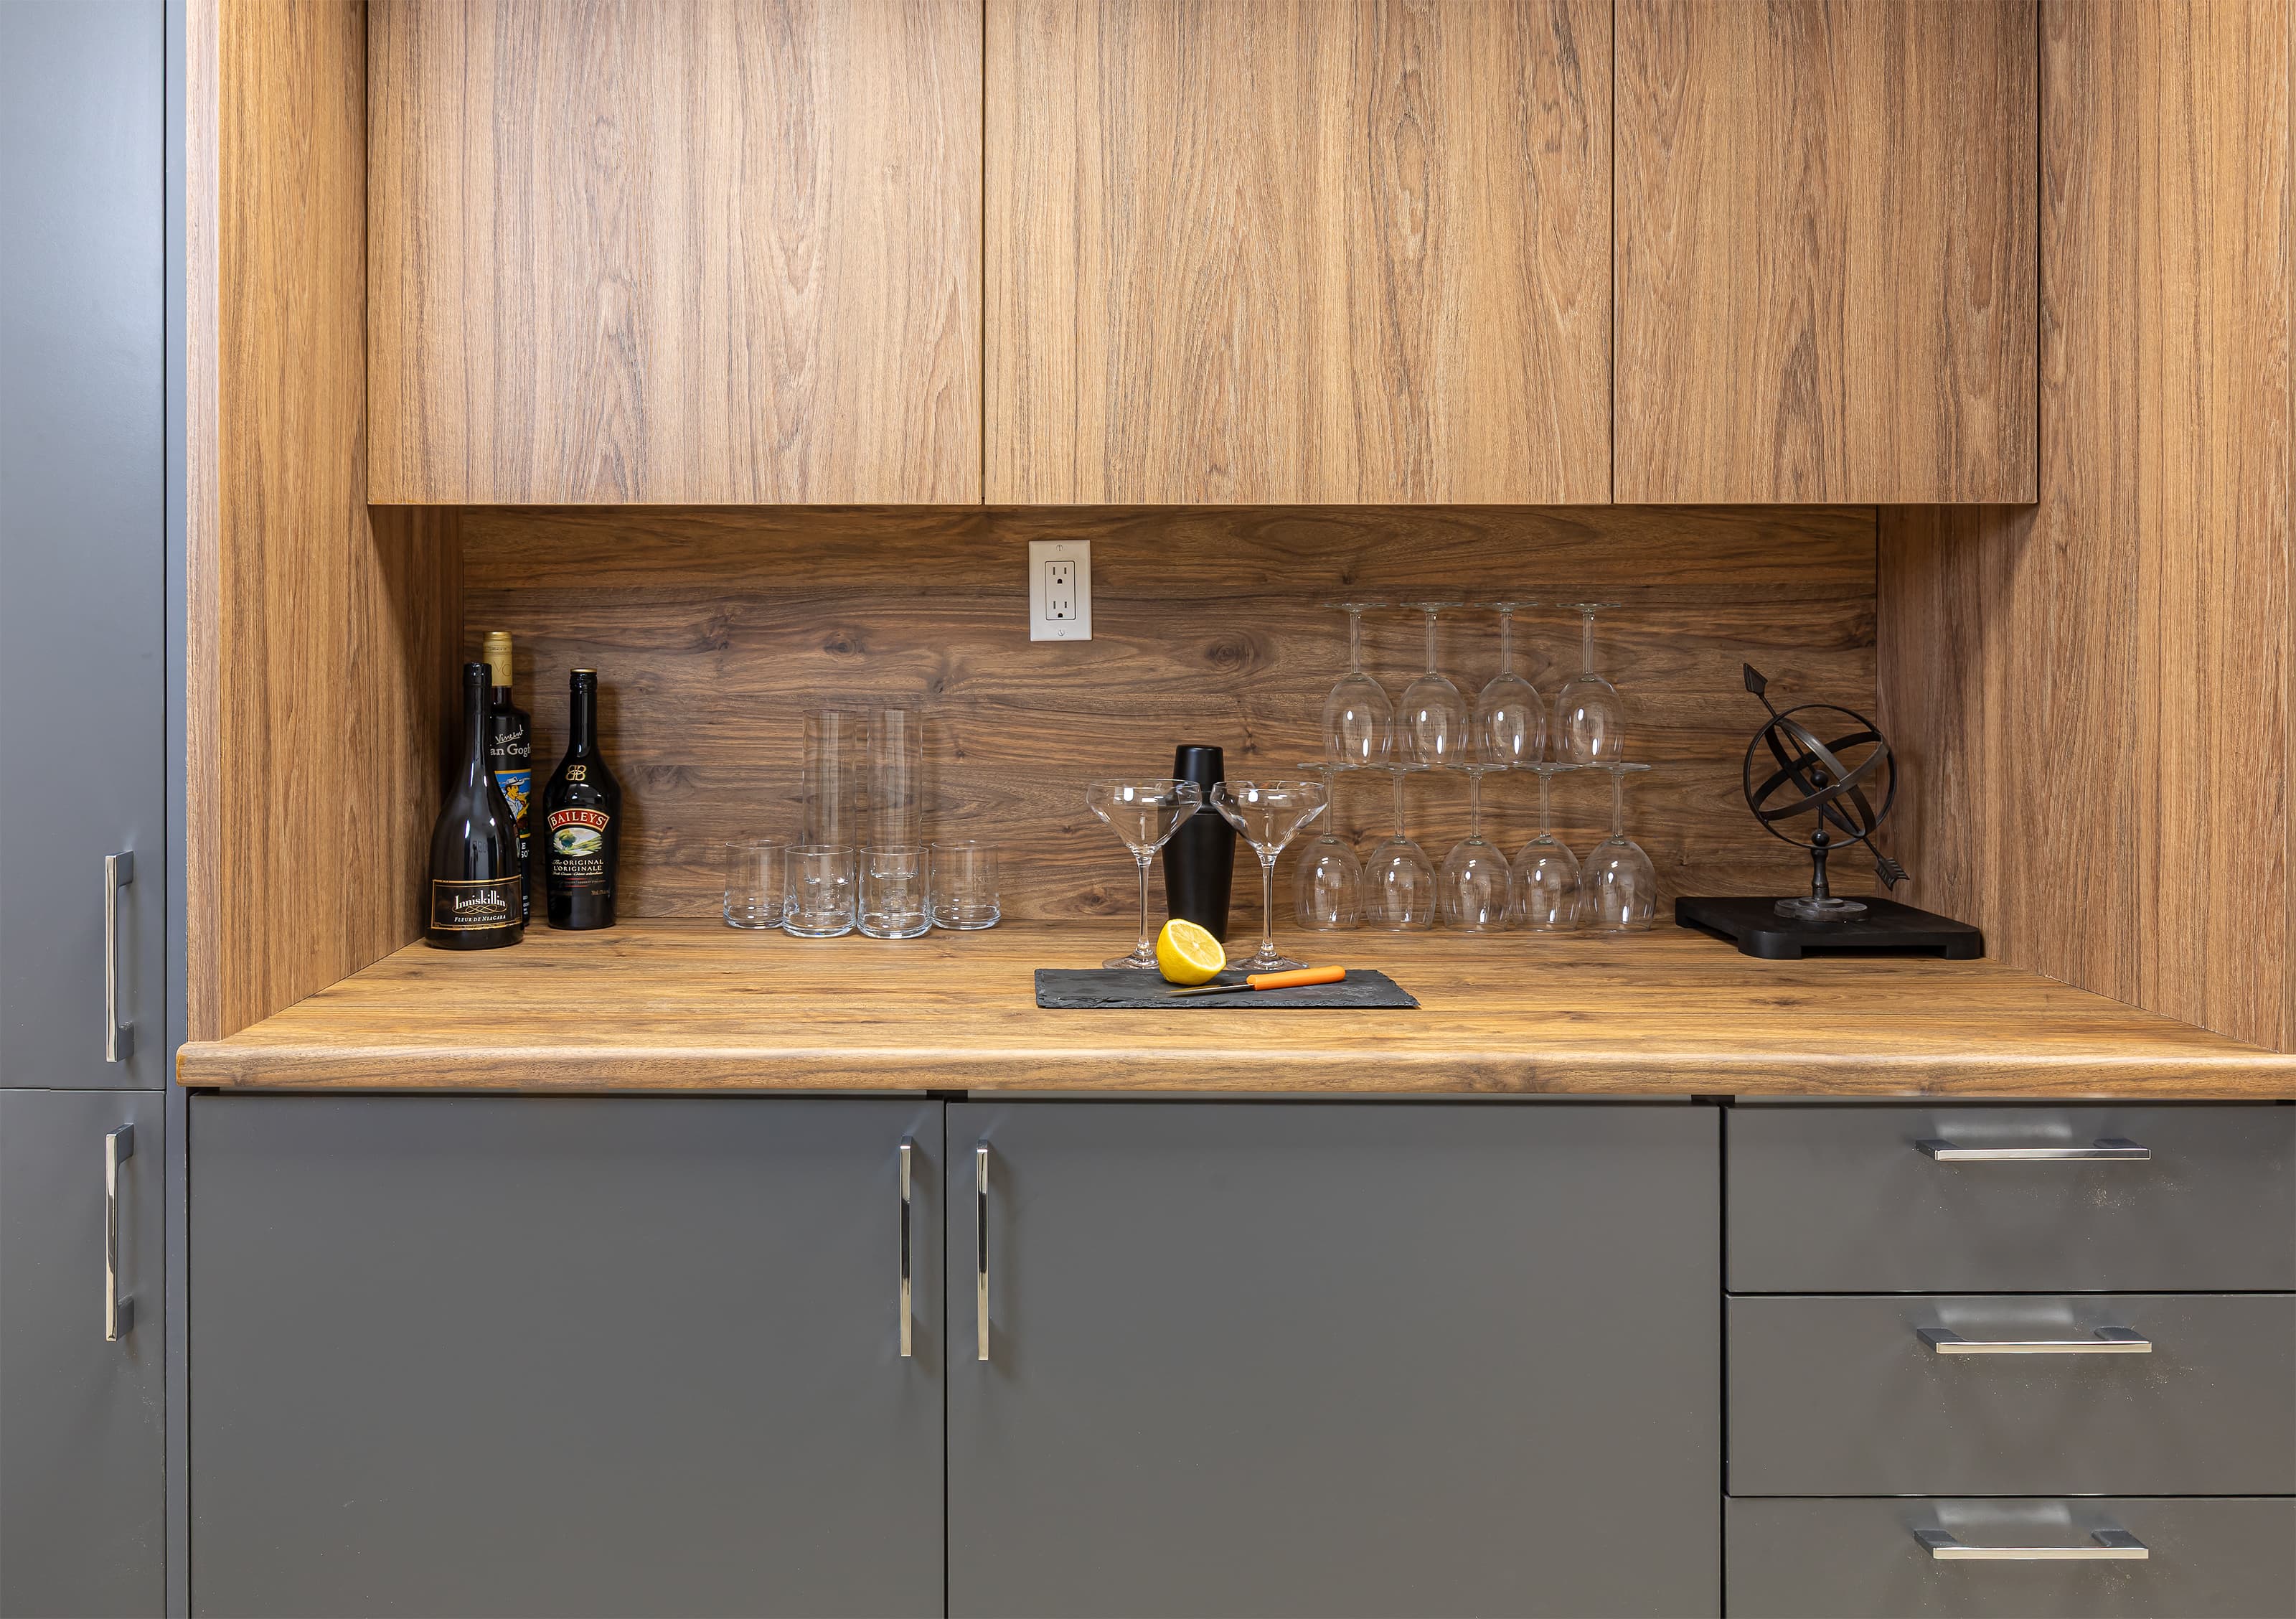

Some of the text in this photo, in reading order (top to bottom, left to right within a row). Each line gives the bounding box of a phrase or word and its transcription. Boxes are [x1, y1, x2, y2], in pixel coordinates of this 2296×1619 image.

[495, 724, 524, 745] Vincent
[489, 747, 505, 756] an
[550, 812, 604, 827] BAILEYS
[454, 889, 506, 911] Inniskillin
